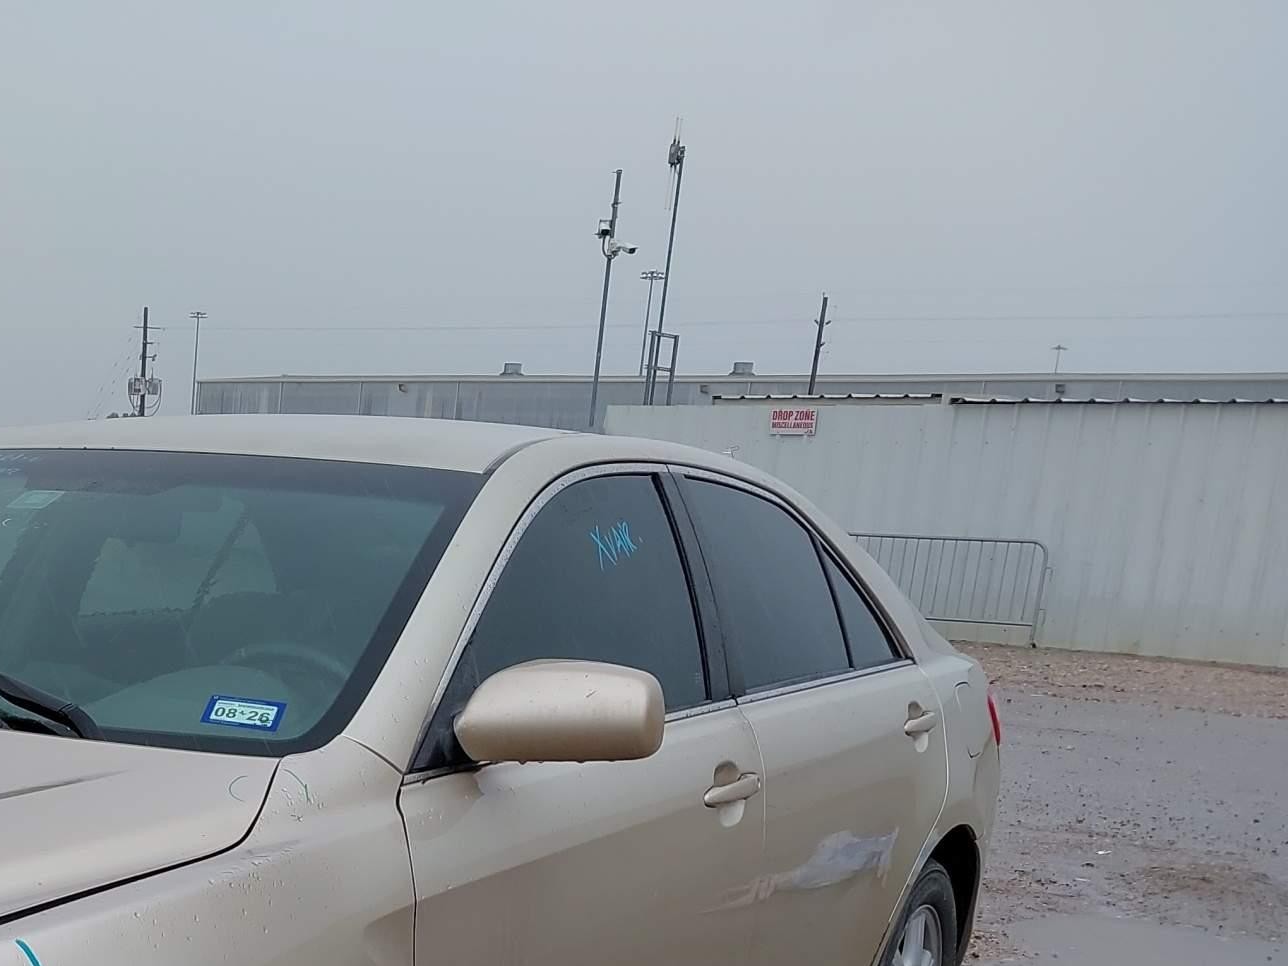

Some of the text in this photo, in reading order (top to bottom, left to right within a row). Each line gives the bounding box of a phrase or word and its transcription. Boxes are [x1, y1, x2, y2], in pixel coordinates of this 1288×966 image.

[772, 410, 816, 421] DROP ZONE
[772, 421, 814, 429] MISCELLANEOUS
[214, 706, 238, 719] 08
[246, 710, 272, 724] 26
